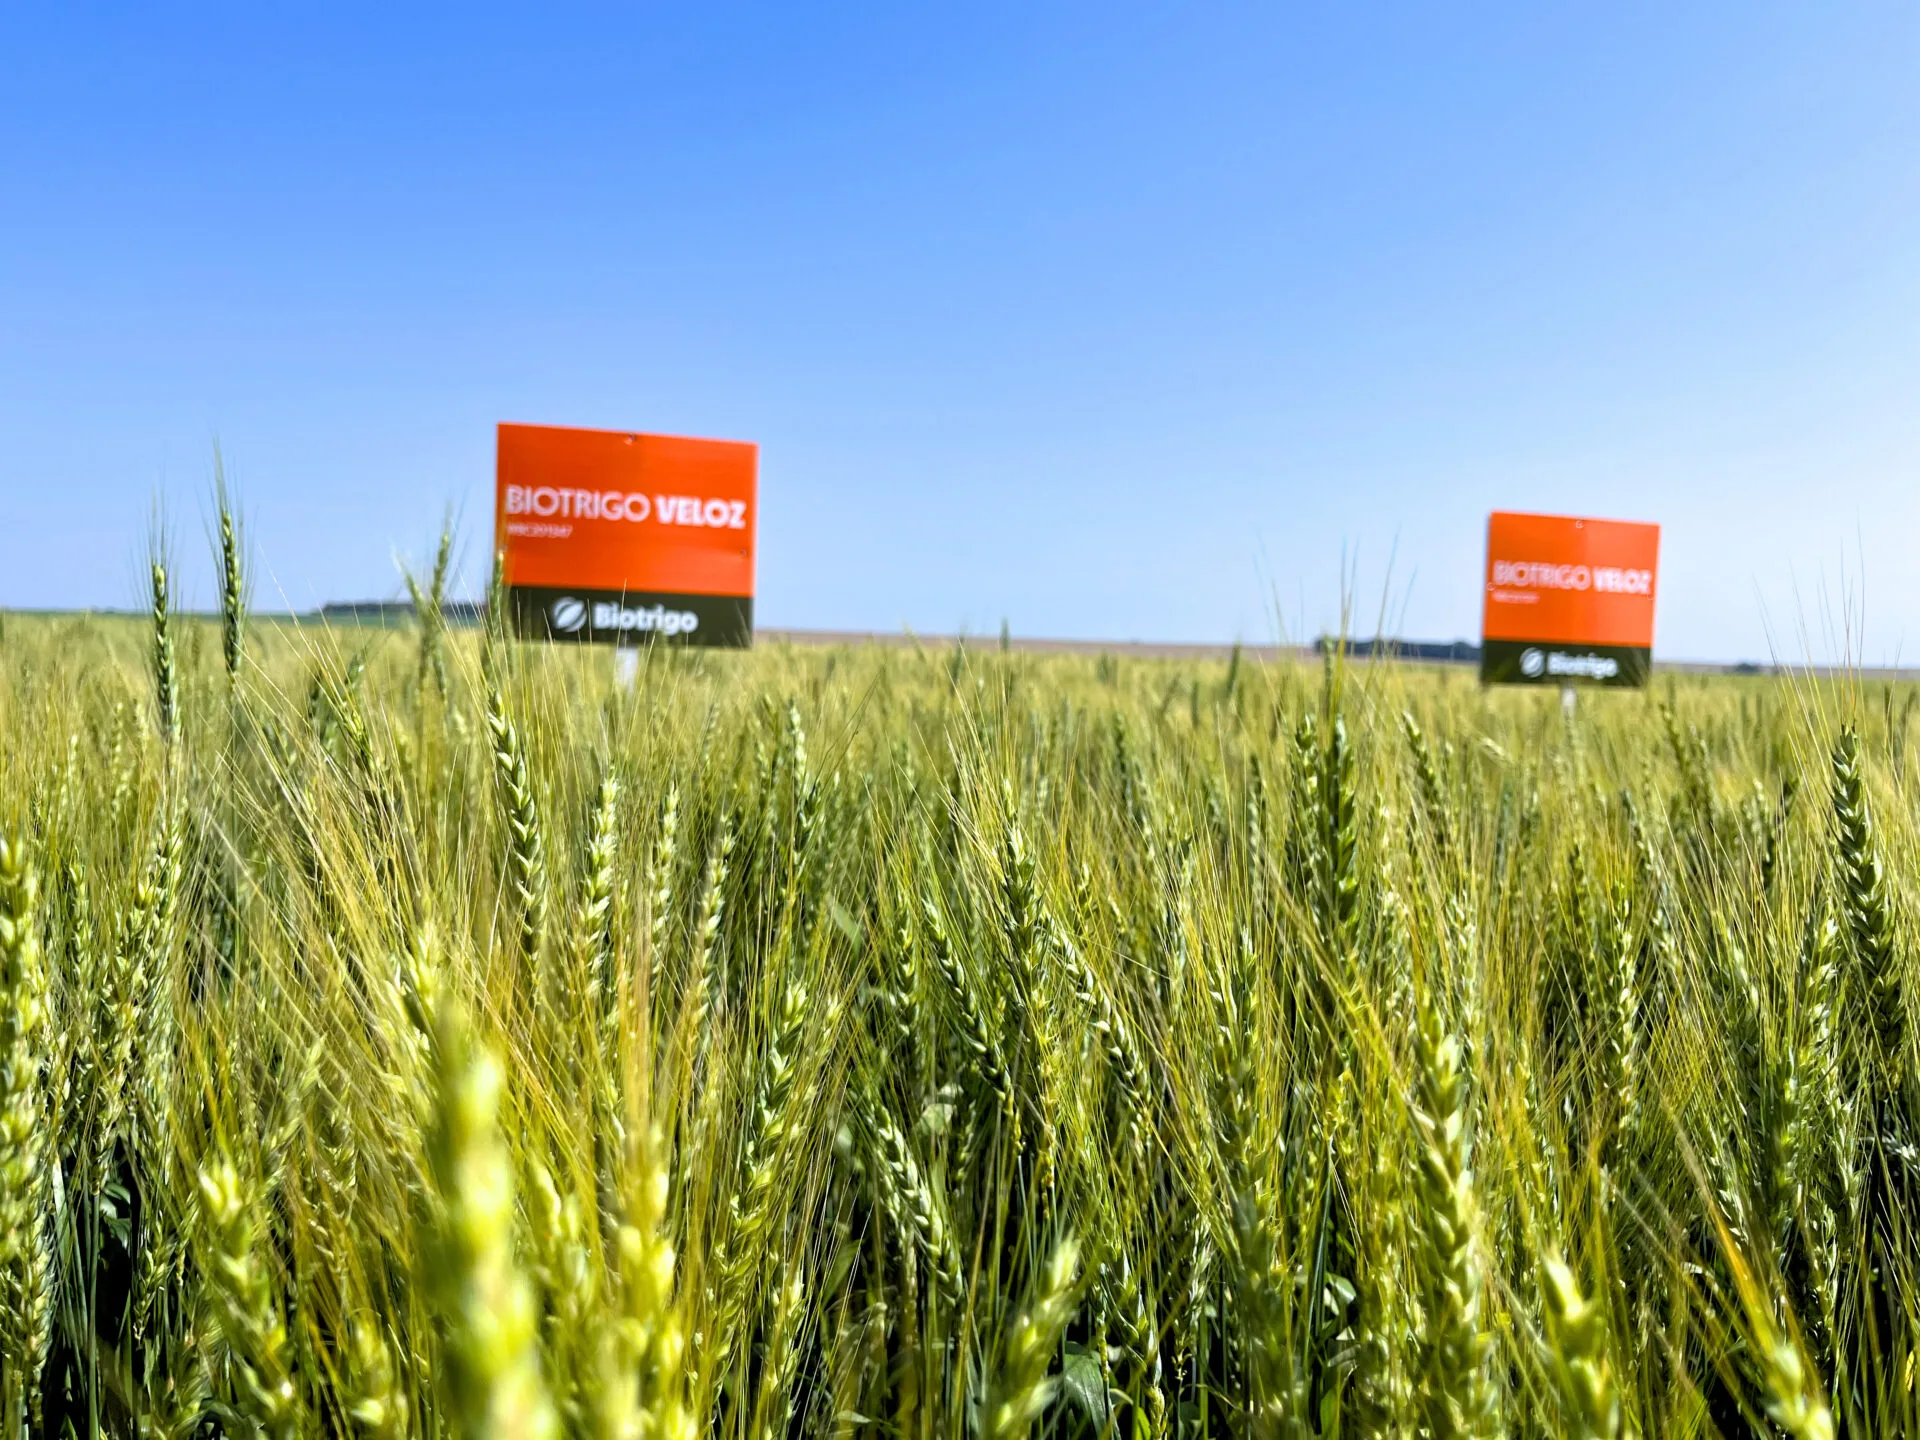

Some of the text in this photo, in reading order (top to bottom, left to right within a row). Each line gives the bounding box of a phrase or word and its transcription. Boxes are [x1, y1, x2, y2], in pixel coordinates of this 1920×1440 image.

[505, 484, 747, 530] BIOTRIGO VELOZ
[594, 602, 699, 636] Biotrigo
